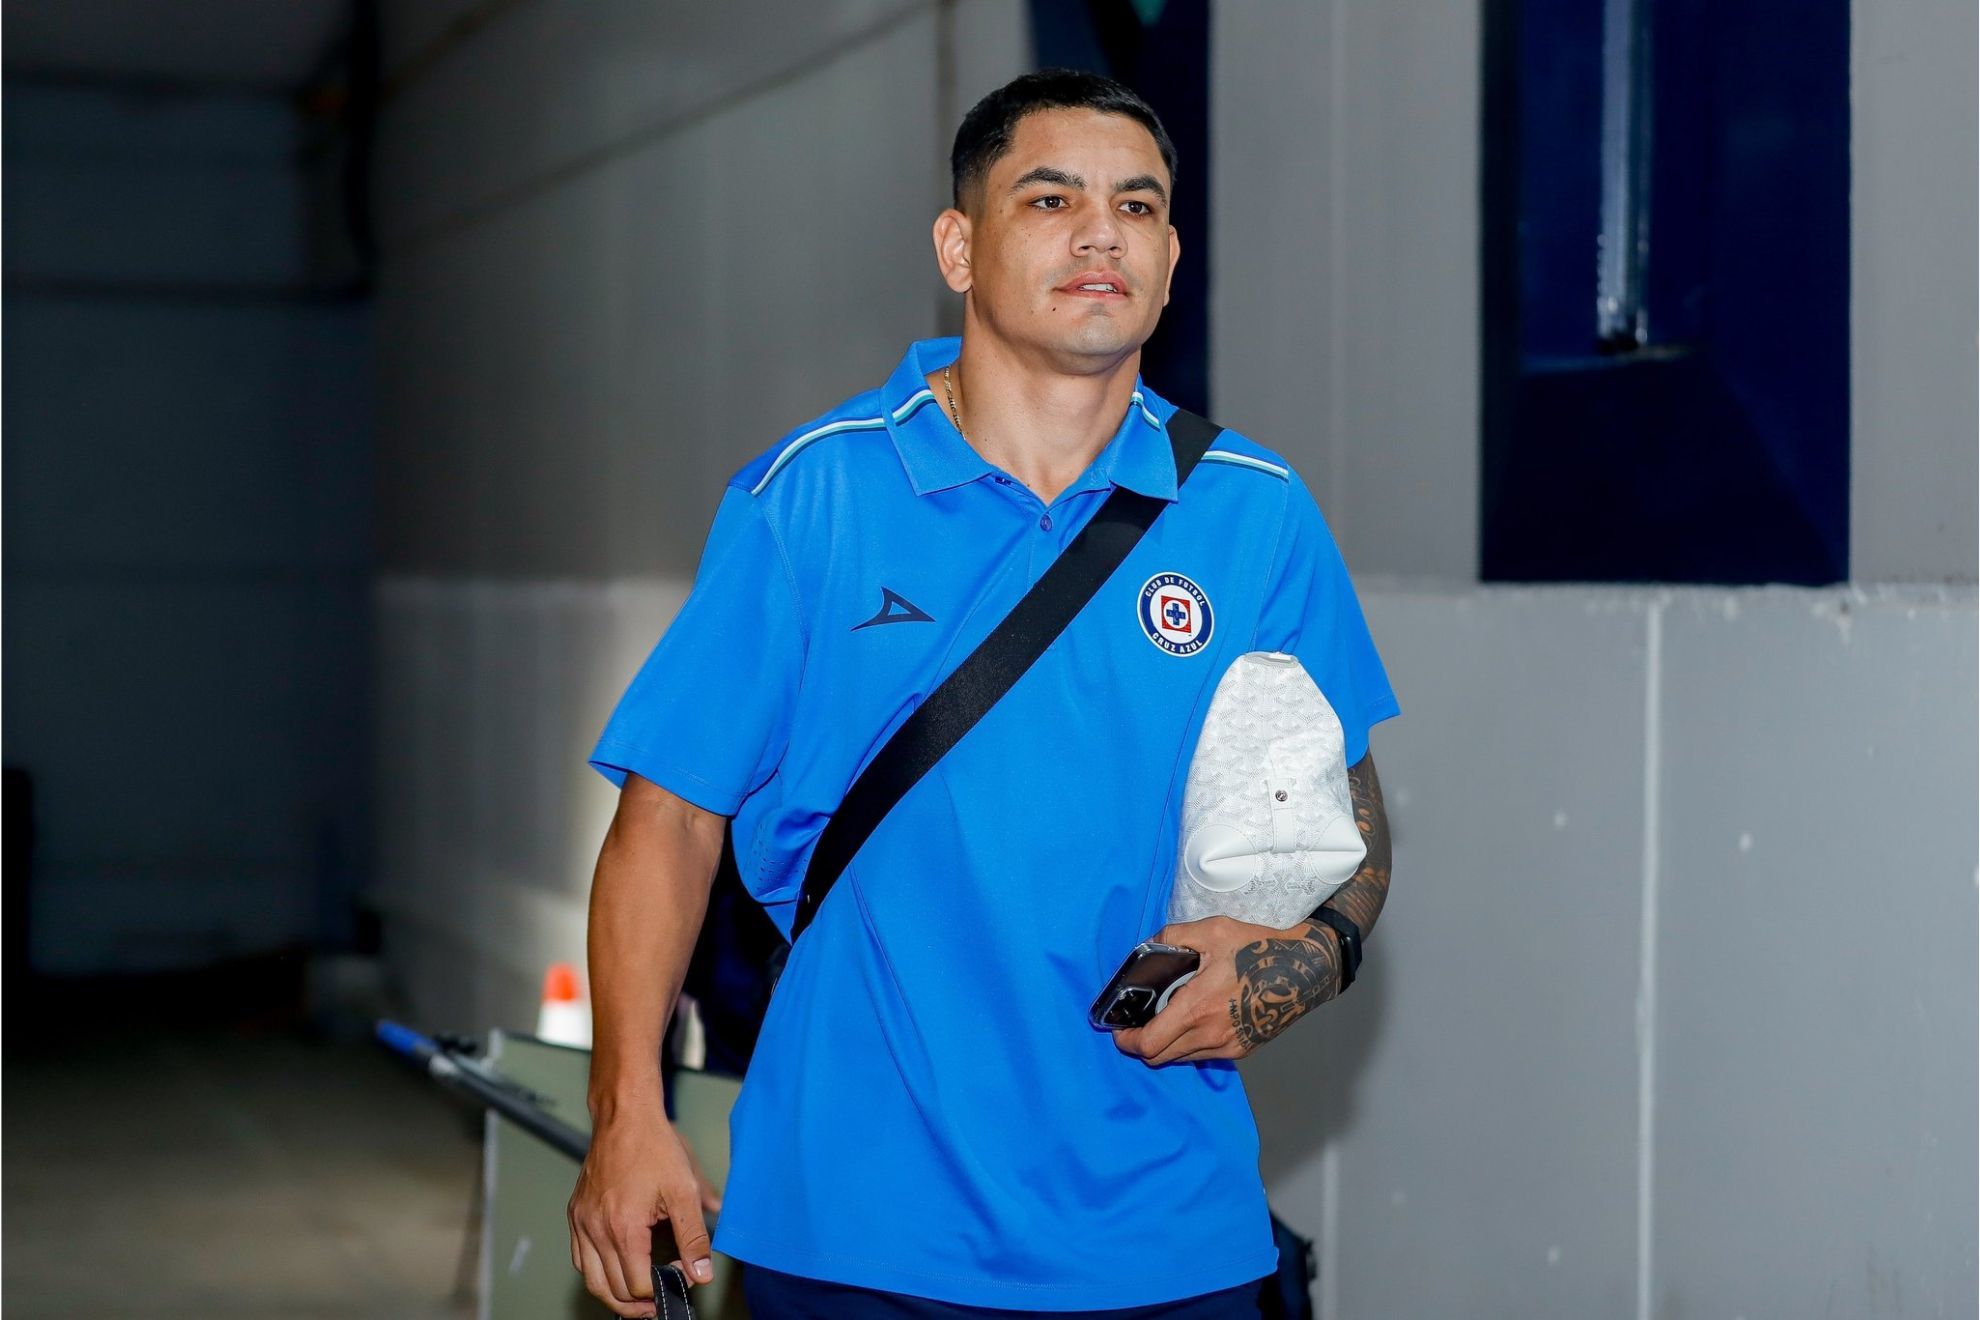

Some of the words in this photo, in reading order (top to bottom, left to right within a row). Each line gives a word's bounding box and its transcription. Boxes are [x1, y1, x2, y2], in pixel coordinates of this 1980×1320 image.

[1145, 579, 1162, 597] CLUB
[1164, 576, 1175, 584] DE
[1178, 578, 1205, 607] FUTBOL
[1152, 632, 1176, 652] CRUZ
[1179, 640, 1203, 653] AZUL
